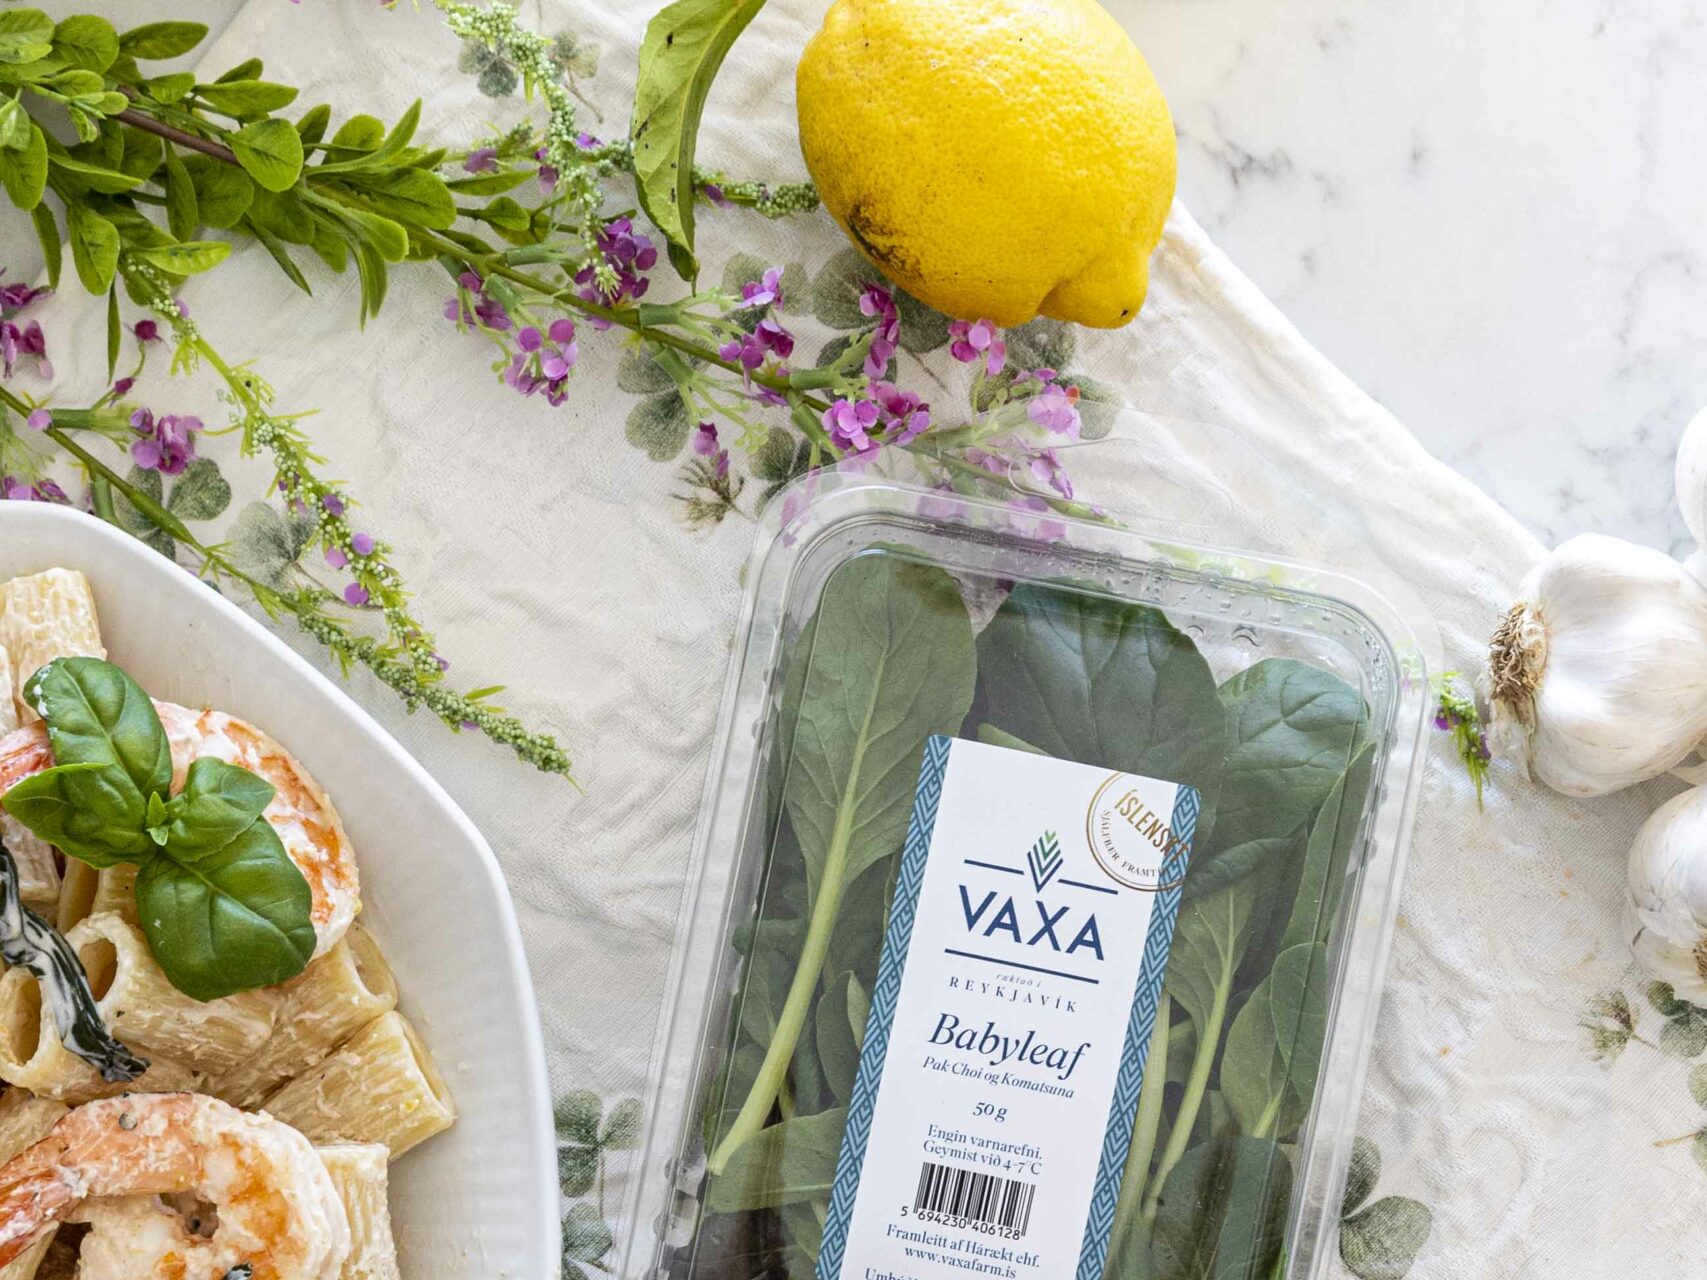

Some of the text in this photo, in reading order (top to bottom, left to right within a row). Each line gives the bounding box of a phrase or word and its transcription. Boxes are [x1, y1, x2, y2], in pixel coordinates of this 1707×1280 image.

[1121, 860, 1168, 878] FRAMT
[959, 884, 1104, 961] VAXA
[949, 976, 1077, 1013] REYKJAVÍK
[929, 1012, 1091, 1080] Babyleaf
[923, 1056, 1075, 1099] Pak Choi og Komatsuna
[972, 1102, 1008, 1122] 50 g
[923, 1140, 977, 1160] Geymist
[981, 1153, 1001, 1168] við
[928, 1124, 1043, 1160] Engin varnarefni.
[901, 1206, 1021, 1241] 5 694230 406128
[886, 1223, 1040, 1268] Framleitt af Hárækt ehf.
[905, 1247, 1016, 1280] www.vaxafarm.is
